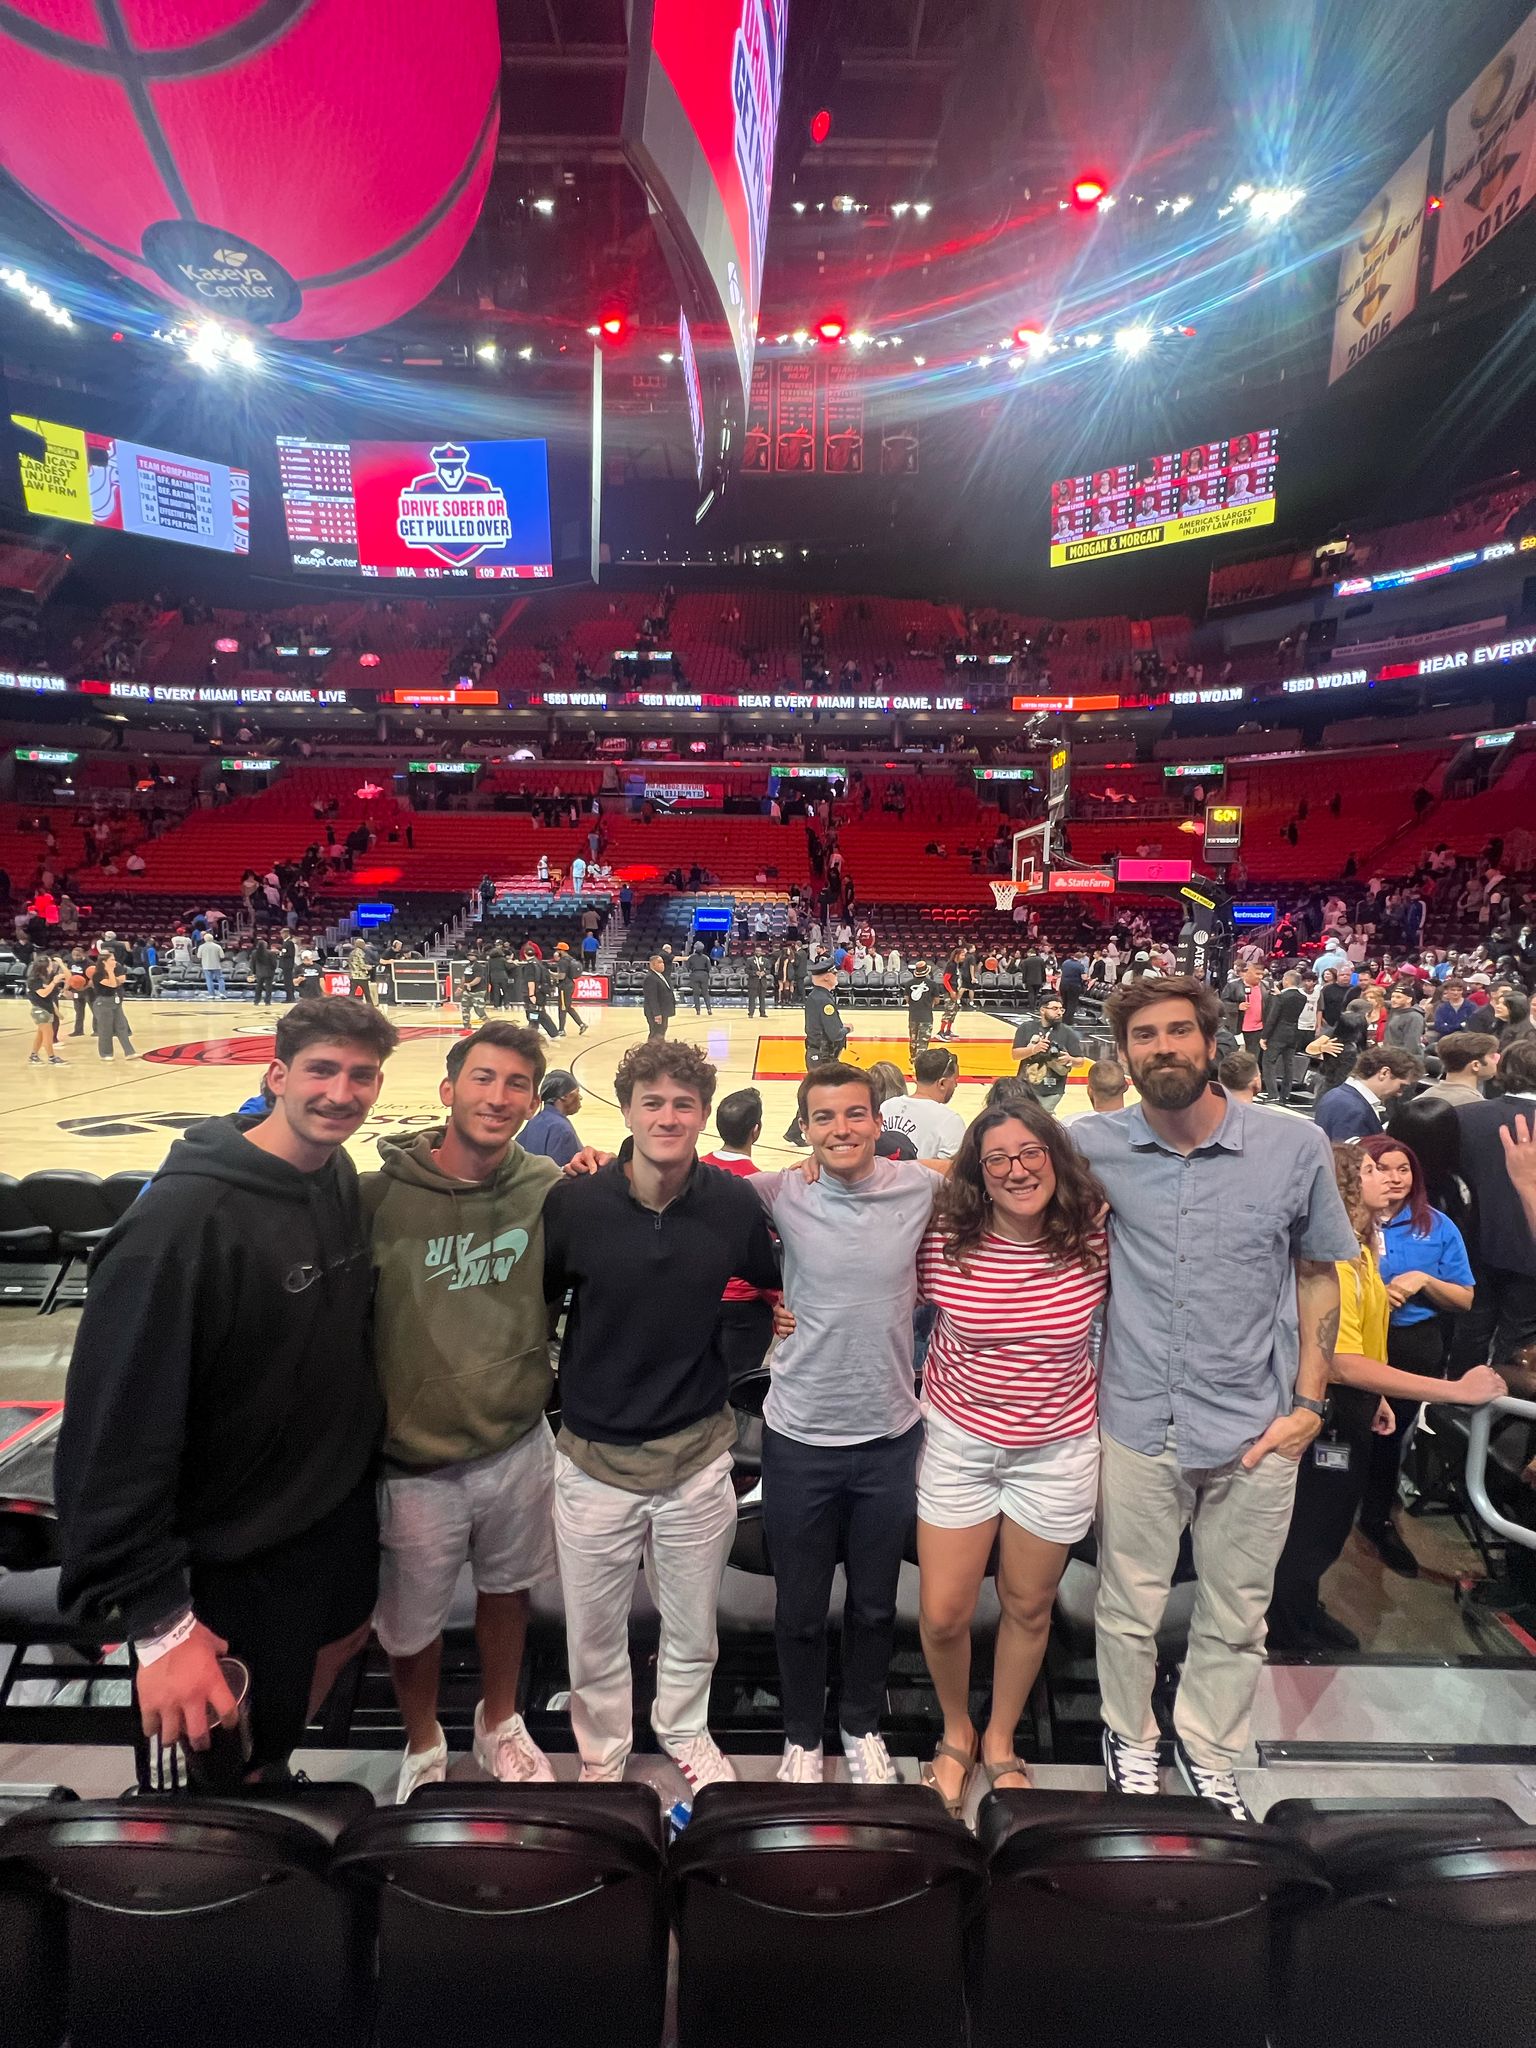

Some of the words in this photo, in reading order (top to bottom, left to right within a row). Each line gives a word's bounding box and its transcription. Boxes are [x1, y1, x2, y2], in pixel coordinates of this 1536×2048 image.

[1460, 186, 1522, 263] 2012
[177, 264, 268, 285] Kaseya
[195, 281, 275, 298] Center
[1346, 312, 1393, 370] 2006
[25, 470, 68, 486] INJURY
[139, 460, 160, 472] TEAM
[160, 465, 210, 482] COMPARISON
[48, 484, 77, 498] FIRM
[402, 500, 440, 517] DRIVE
[443, 500, 484, 517] SOBER
[488, 500, 505, 517] OR
[1178, 516, 1220, 530] AMERICA'S
[1222, 507, 1258, 521] LARGEST
[1182, 525, 1211, 536] INJURY
[1212, 521, 1229, 532] LAW
[1230, 516, 1252, 528] FIRM
[400, 519, 424, 537] GET
[427, 520, 474, 536] PULLED
[478, 520, 510, 536] OVER
[1069, 540, 1108, 560] MORGAN
[1110, 536, 1117, 550] &
[1118, 530, 1160, 549] MORGAN
[294, 554, 326, 568] Kaseya
[326, 556, 358, 567] Center
[396, 566, 416, 577] MIA
[424, 568, 440, 578] 131
[479, 567, 494, 578] 109
[501, 566, 519, 578] ATL
[1420, 652, 1468, 674] HEAR
[1474, 638, 1536, 664] EVERY
[110, 682, 150, 698] HEAR
[154, 686, 196, 700] EVERY
[200, 688, 238, 701] MIAMI
[241, 689, 273, 702] HEAT
[275, 690, 316, 702] GAME.
[318, 690, 347, 703] LIVE
[738, 695, 770, 708] HEAR
[774, 696, 813, 708] EVERY
[817, 696, 854, 708] MIAMI
[859, 697, 890, 709] HEAT
[893, 697, 932, 710] GAME.
[936, 698, 963, 710] LIVE
[242, 760, 271, 770] BACARDI
[436, 763, 465, 772] BACARDI
[799, 767, 826, 777] BACARDI
[1185, 764, 1212, 775] BACARDI
[993, 769, 1021, 780] BACARDI
[578, 978, 602, 990] PAPA
[424, 1232, 474, 1266] AIR
[447, 1256, 515, 1290] NIKE
